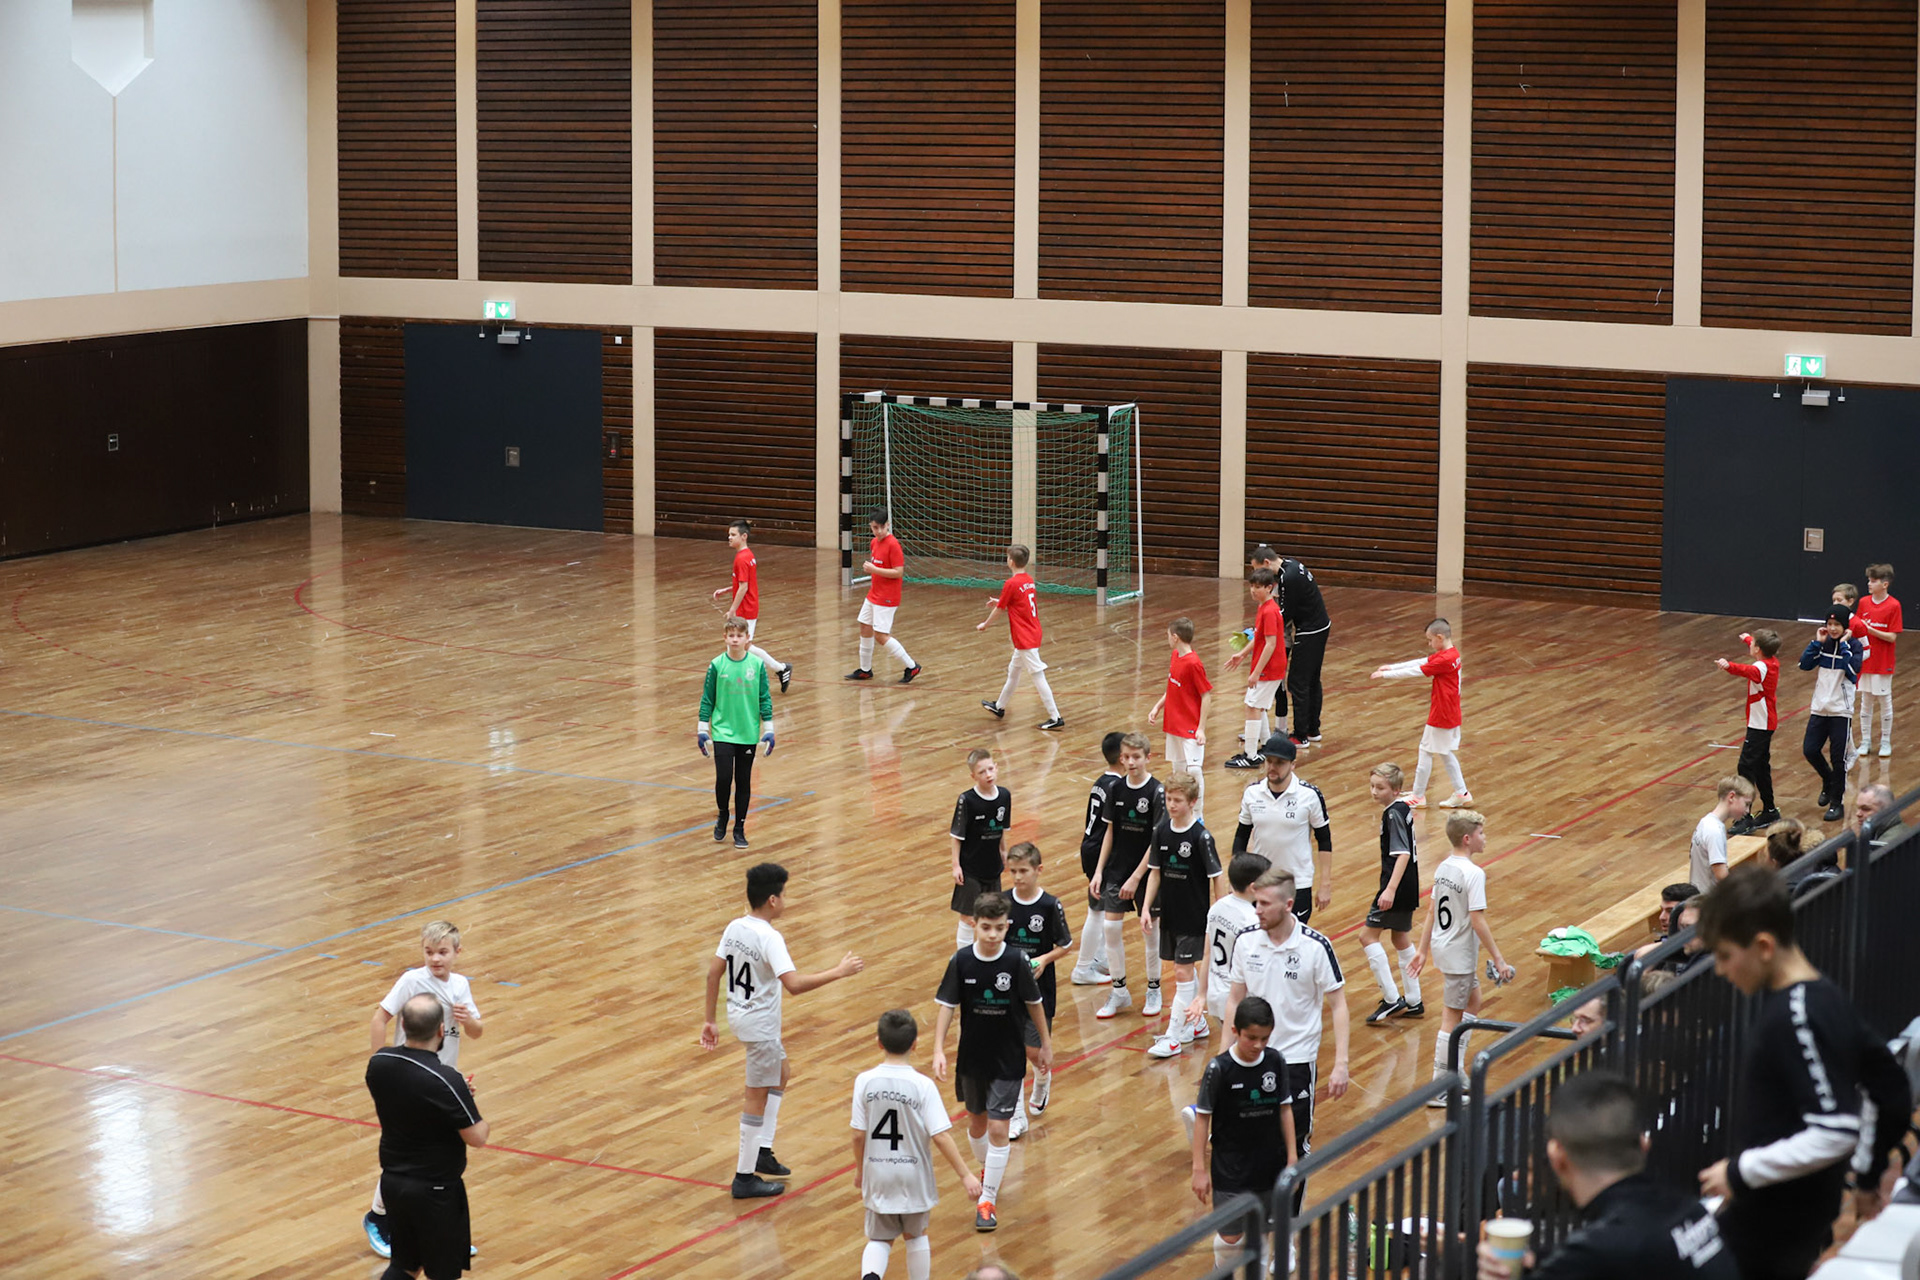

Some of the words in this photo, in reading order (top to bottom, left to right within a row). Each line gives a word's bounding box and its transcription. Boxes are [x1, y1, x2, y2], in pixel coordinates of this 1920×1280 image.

[1028, 593, 1036, 617] 5
[1285, 811, 1296, 819] CR
[1438, 895, 1452, 930] 6
[1213, 928, 1227, 966] 5
[726, 954, 755, 1000] 14
[1284, 971, 1298, 980] MB
[866, 1091, 880, 1104] SK
[871, 1109, 904, 1151] 4
